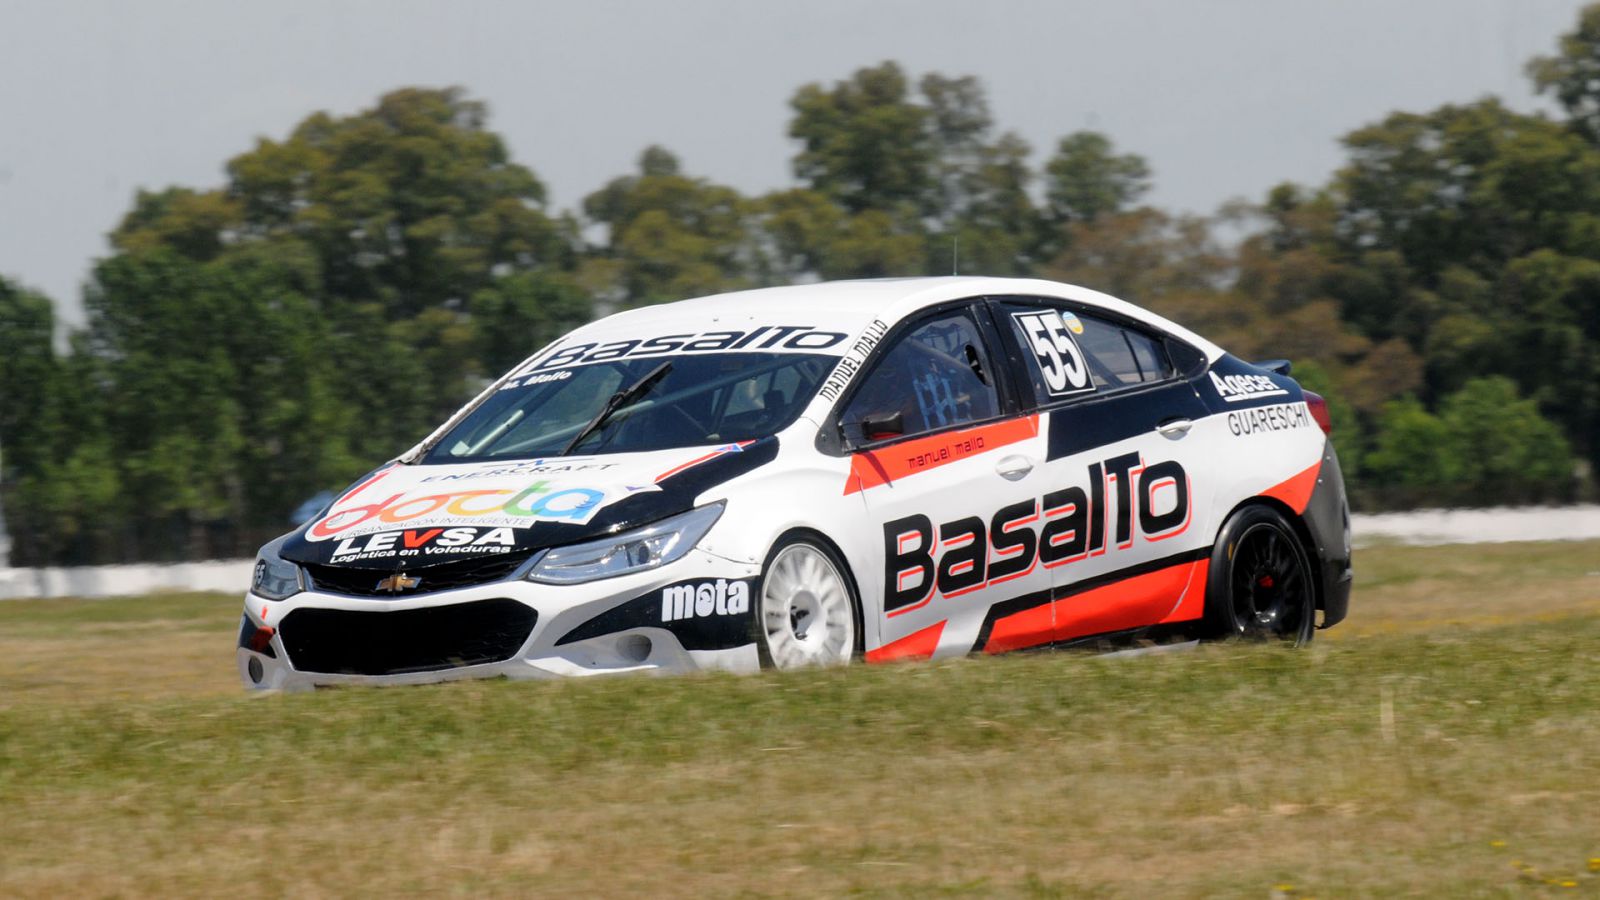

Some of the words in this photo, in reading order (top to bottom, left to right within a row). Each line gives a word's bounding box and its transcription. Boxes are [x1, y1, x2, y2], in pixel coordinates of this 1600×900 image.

[819, 356, 862, 402] MANUEL
[852, 319, 889, 358] MALLO
[1020, 313, 1087, 391] 55
[522, 371, 573, 386] Mallo
[1228, 404, 1309, 436] GUARESCHI
[908, 445, 951, 469] manuel
[954, 436, 985, 455] mallo
[420, 463, 620, 483] ENERCRAFT
[312, 480, 604, 537] docta
[333, 527, 516, 556] LEVSA
[399, 549, 419, 557] en
[424, 545, 511, 555] Voladuras
[661, 579, 749, 622] mota
